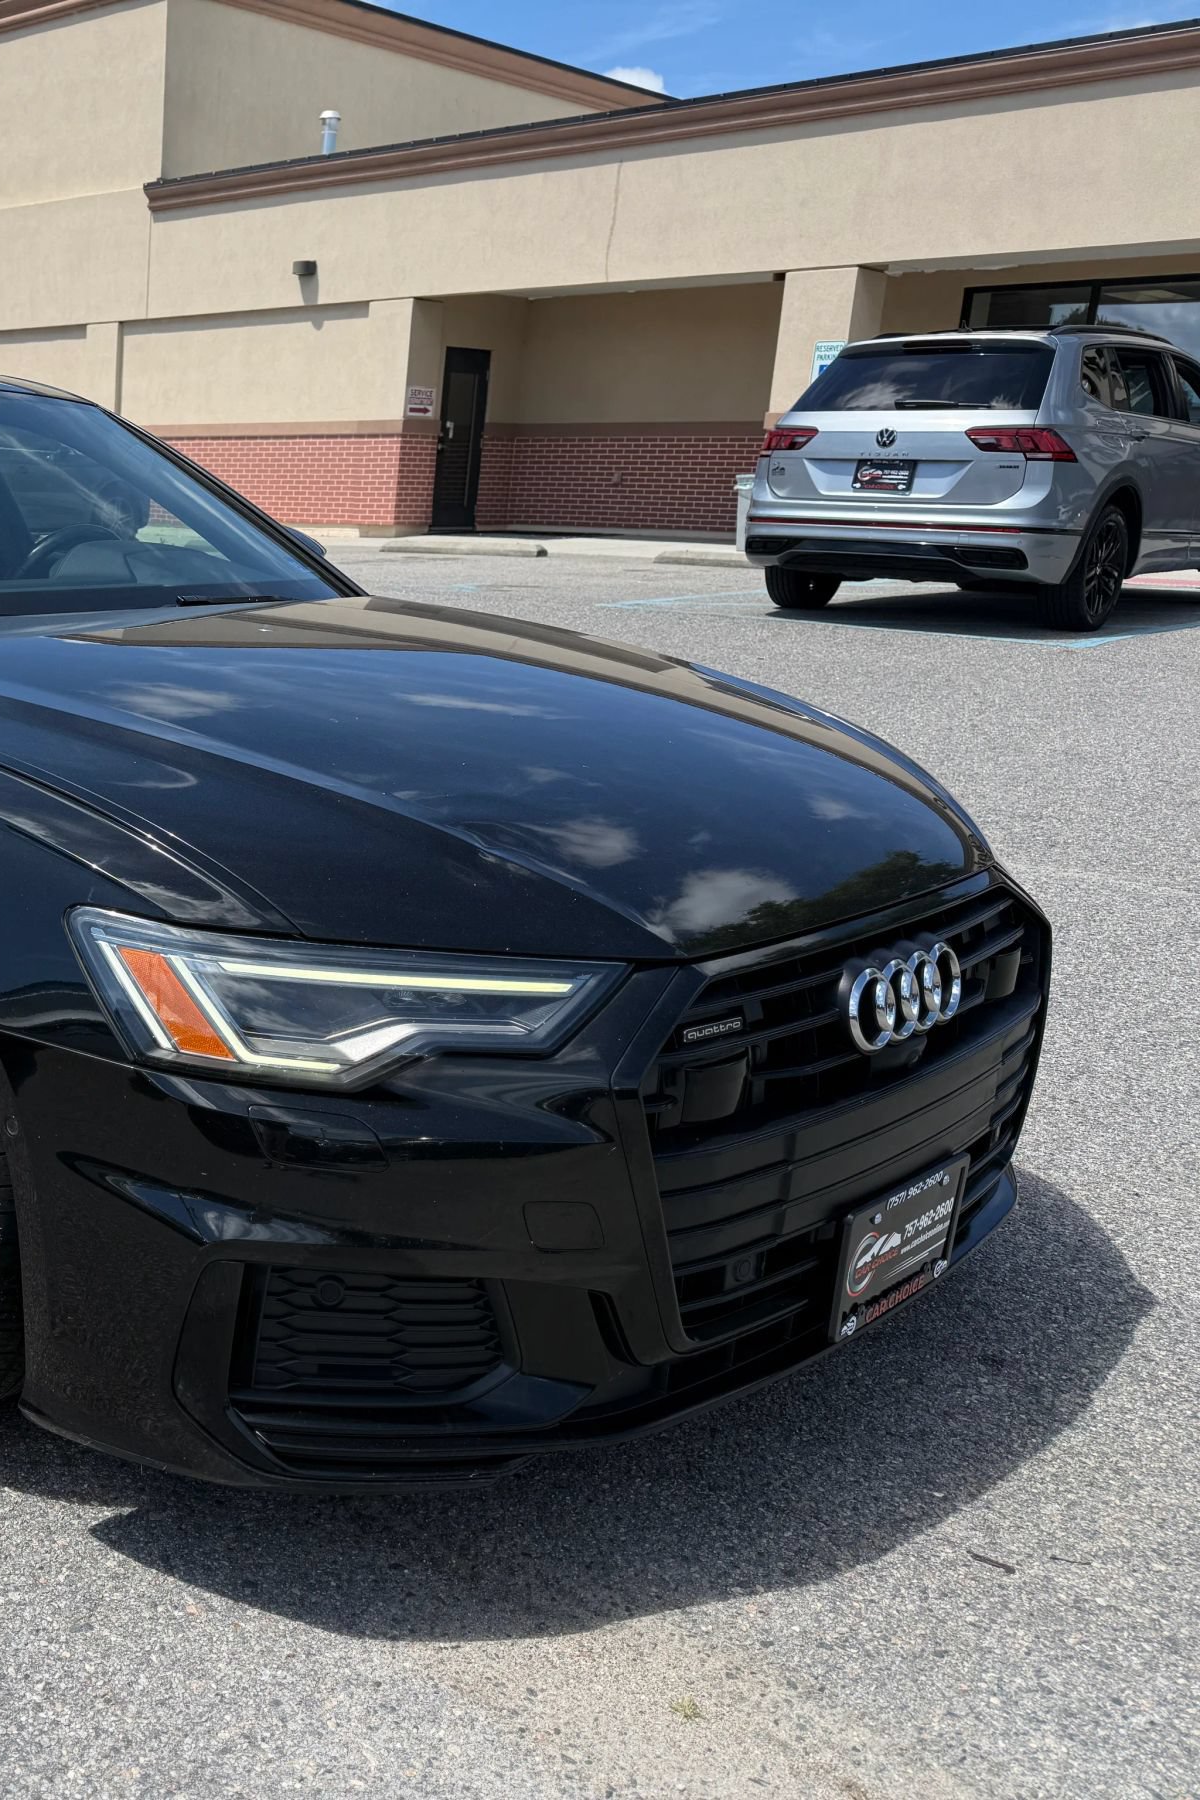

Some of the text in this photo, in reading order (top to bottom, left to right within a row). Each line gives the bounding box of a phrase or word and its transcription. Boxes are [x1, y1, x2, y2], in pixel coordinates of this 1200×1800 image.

[410, 388, 433, 397] SERVICE
[687, 1021, 741, 1040] quattro
[907, 1170, 944, 1200] 962-2600
[903, 1197, 954, 1241] 757-962-2600
[855, 1247, 899, 1279] CAR CHOICE
[865, 1274, 926, 1323] CAR CHOICE
